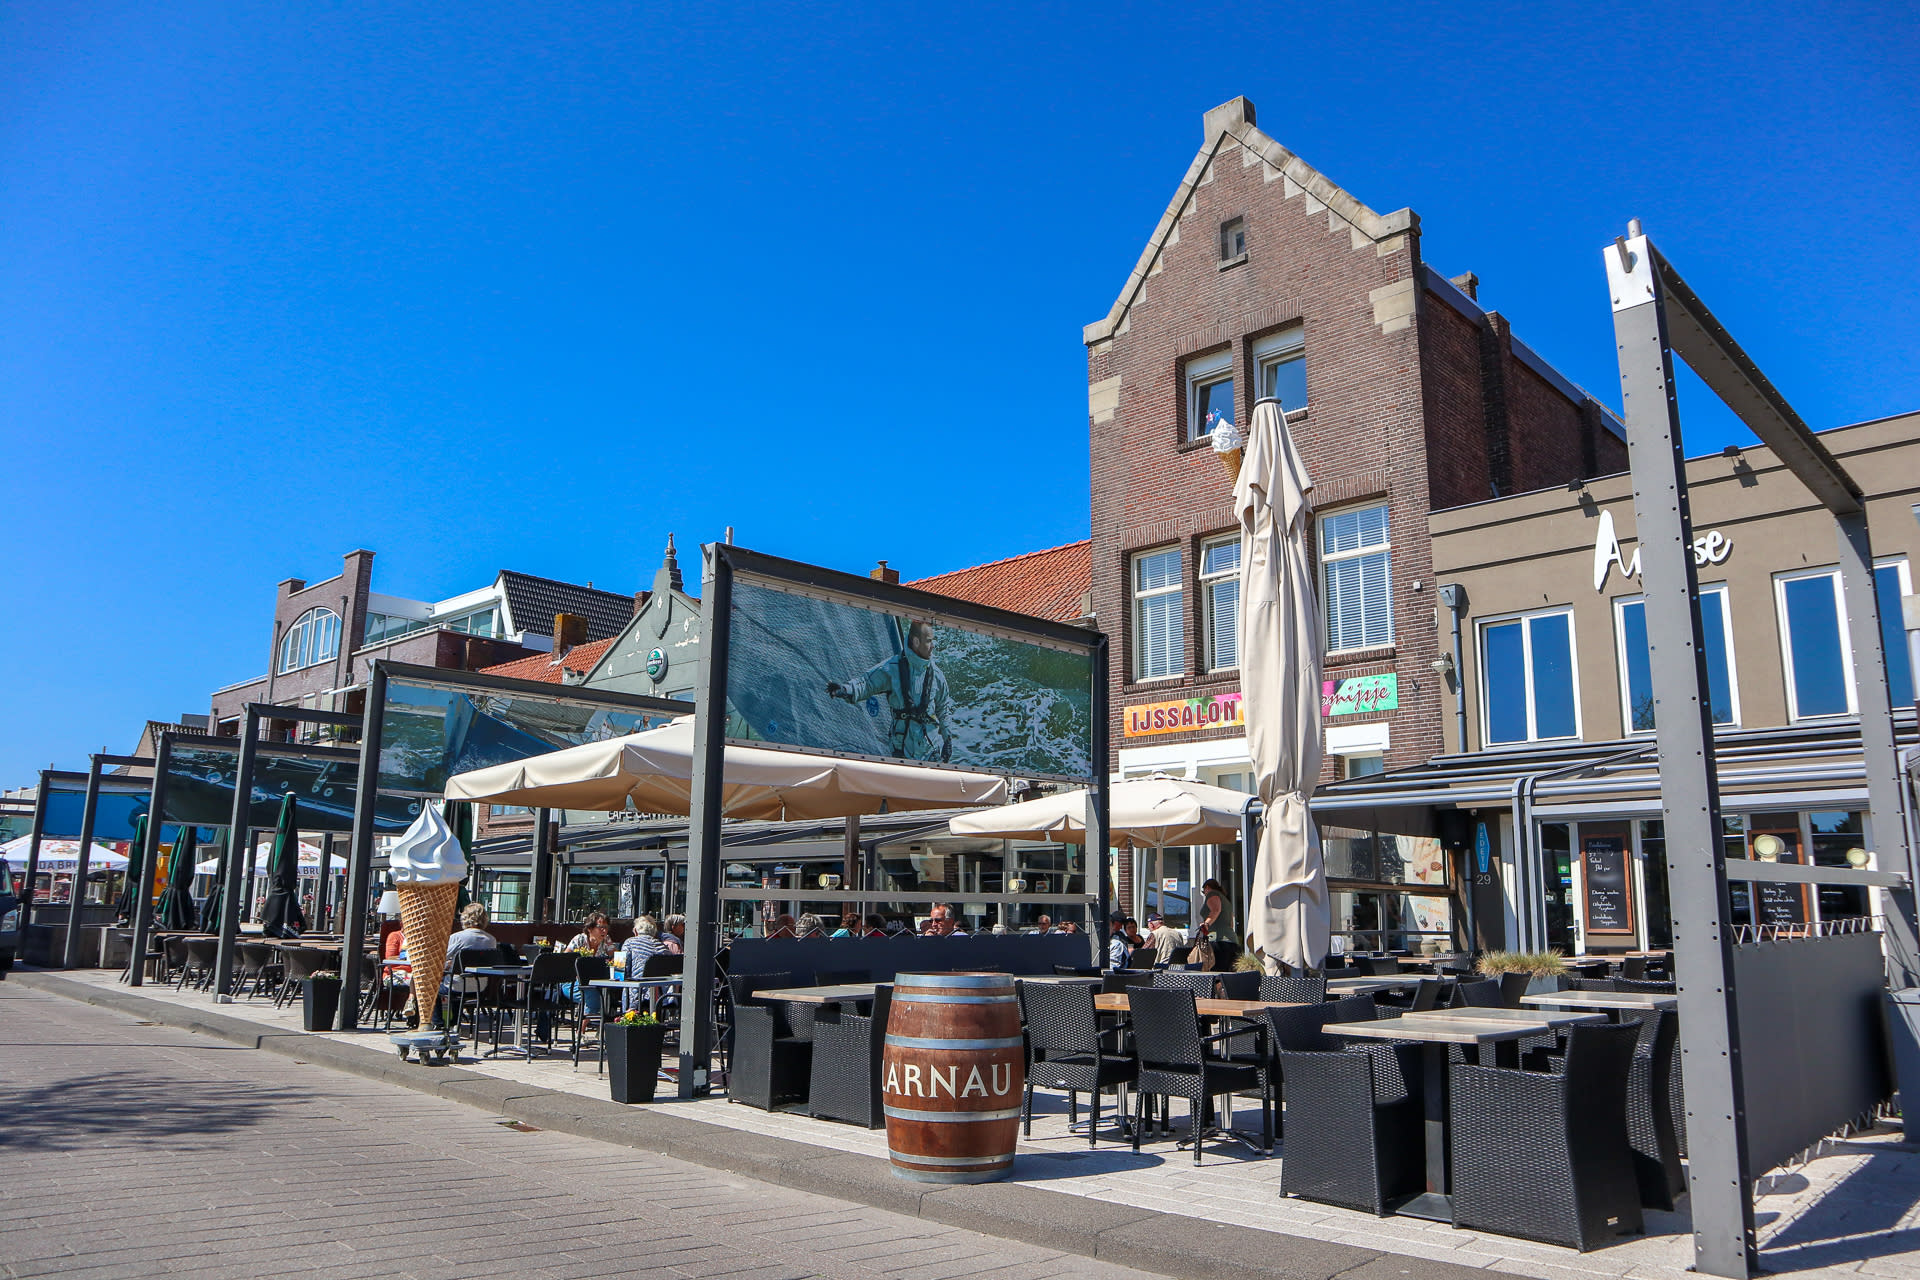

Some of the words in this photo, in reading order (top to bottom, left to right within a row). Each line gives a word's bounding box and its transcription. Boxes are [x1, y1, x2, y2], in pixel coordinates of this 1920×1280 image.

[1594, 509, 1732, 591] Ase
[1131, 699, 1238, 732] IJSSALON
[39, 861, 54, 870] DA
[57, 861, 95, 870] BRO
[1476, 874, 1491, 885] 29
